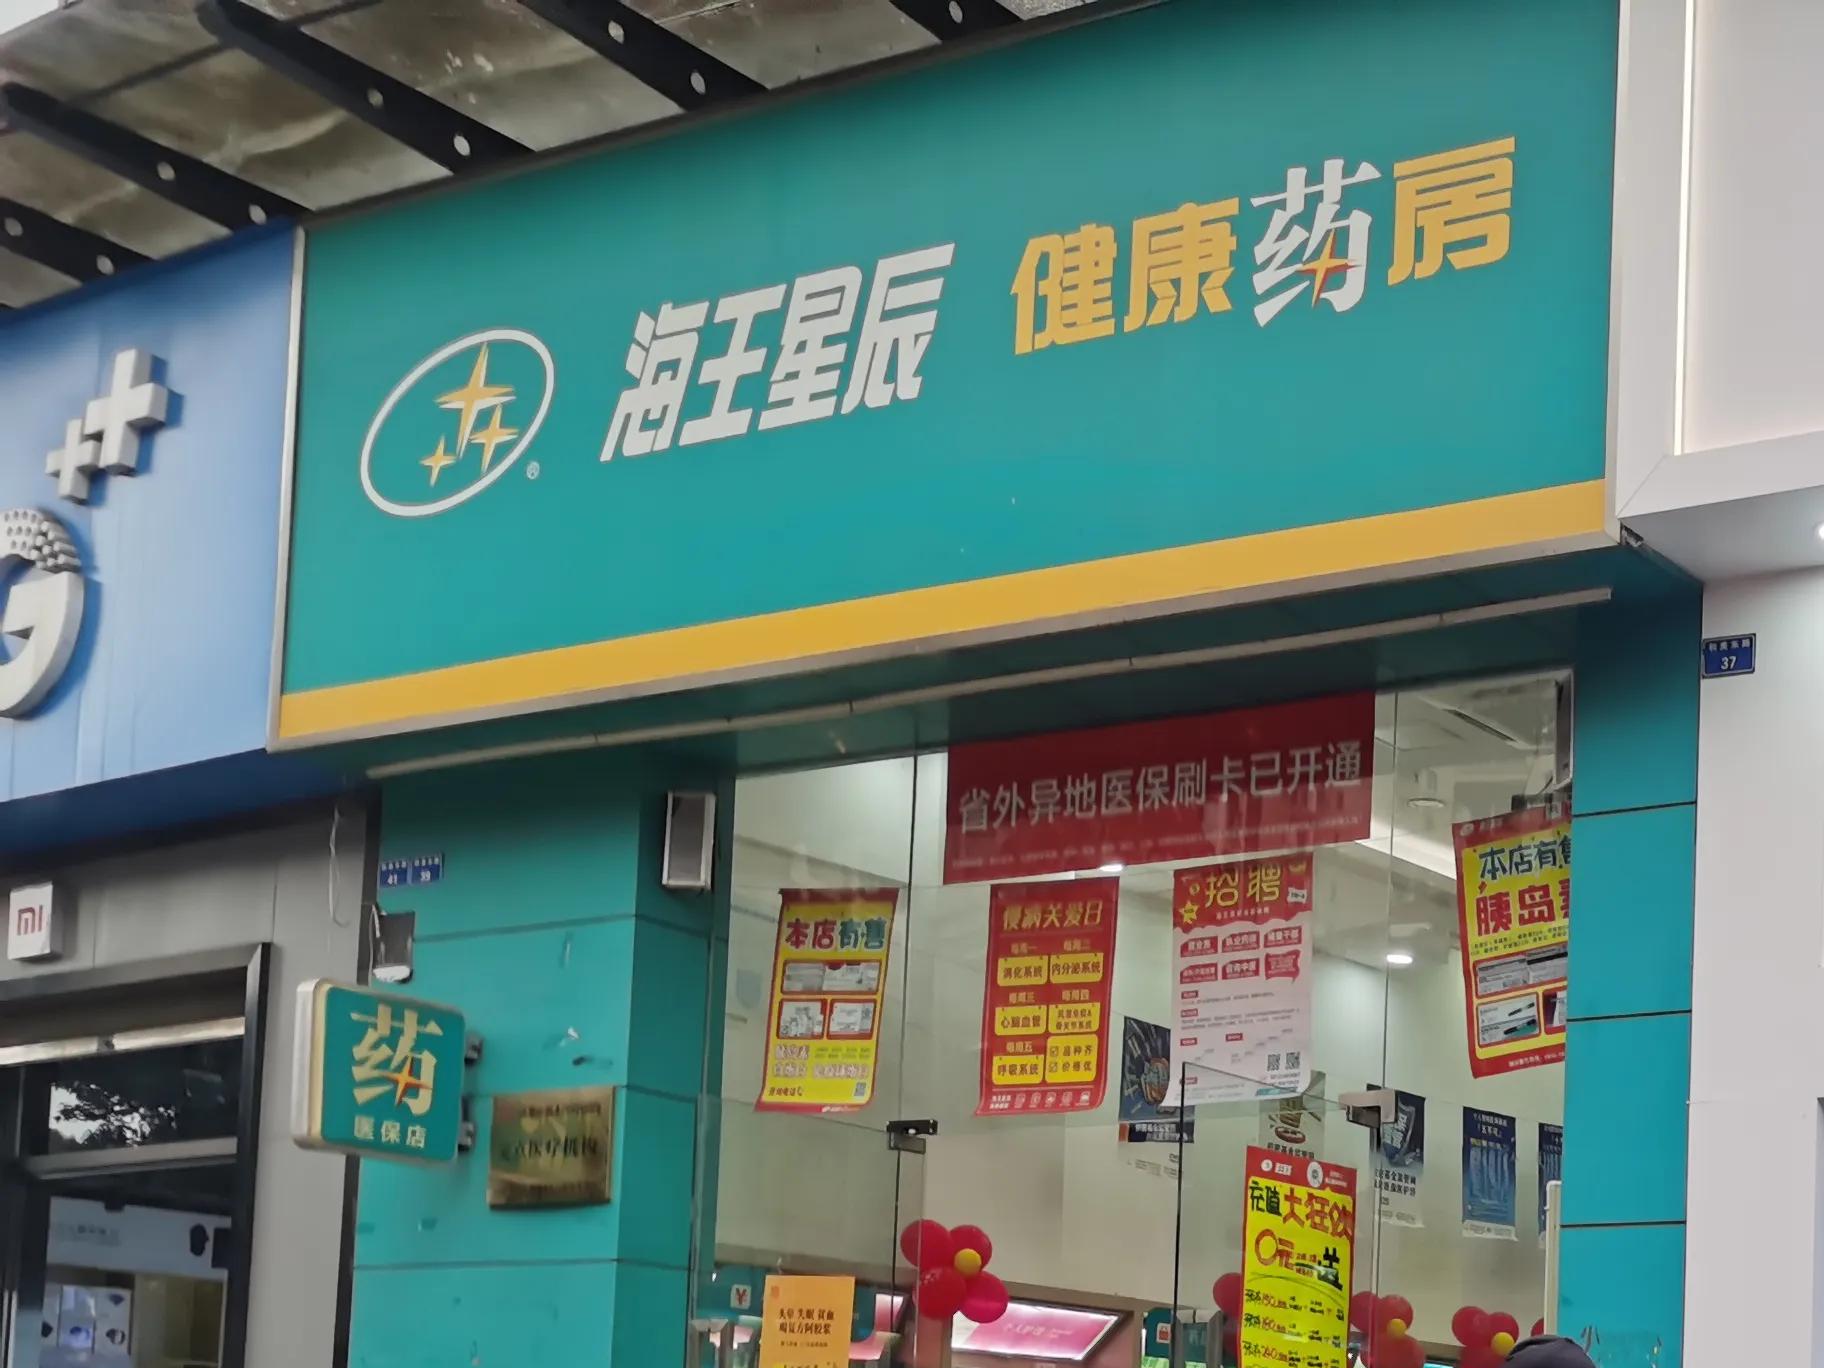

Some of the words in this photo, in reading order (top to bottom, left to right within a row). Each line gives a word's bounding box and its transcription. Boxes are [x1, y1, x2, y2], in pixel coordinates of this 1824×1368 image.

[600, 241, 957, 463] 海王星辰
[1010, 136, 1516, 355] 健康药房
[1721, 656, 1737, 670] 37
[959, 740, 1361, 834] 省外异地医保刷卡已开通
[1205, 861, 1282, 907] 招聘
[1476, 879, 1570, 937] 胰岛
[350, 1003, 444, 1116] 药
